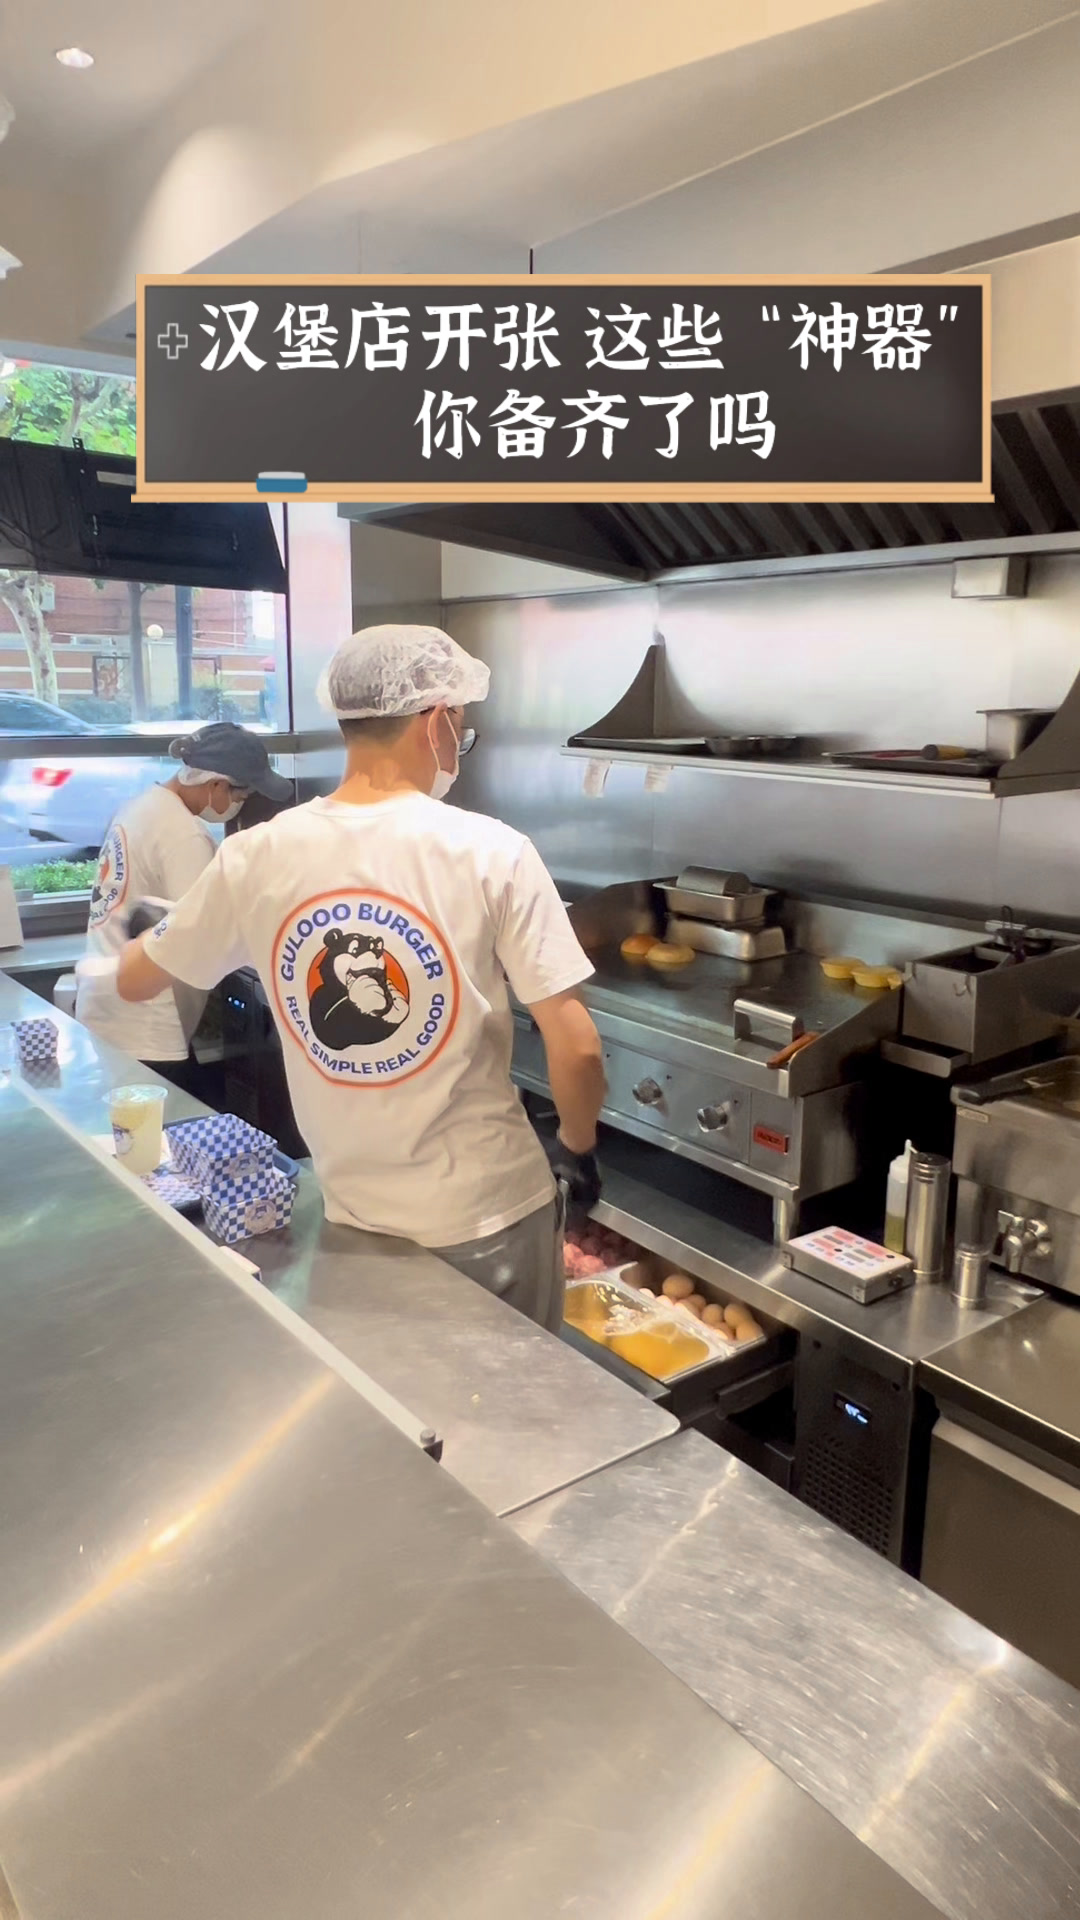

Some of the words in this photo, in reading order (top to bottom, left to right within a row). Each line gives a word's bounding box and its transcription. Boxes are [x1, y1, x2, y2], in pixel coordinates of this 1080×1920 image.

[281, 903, 351, 982] GULOOO
[358, 902, 444, 980] BURGER
[286, 996, 310, 1042] REAL
[310, 1042, 373, 1074] SIMPLE
[376, 1047, 421, 1074] REAL
[416, 993, 445, 1046] GOOD
